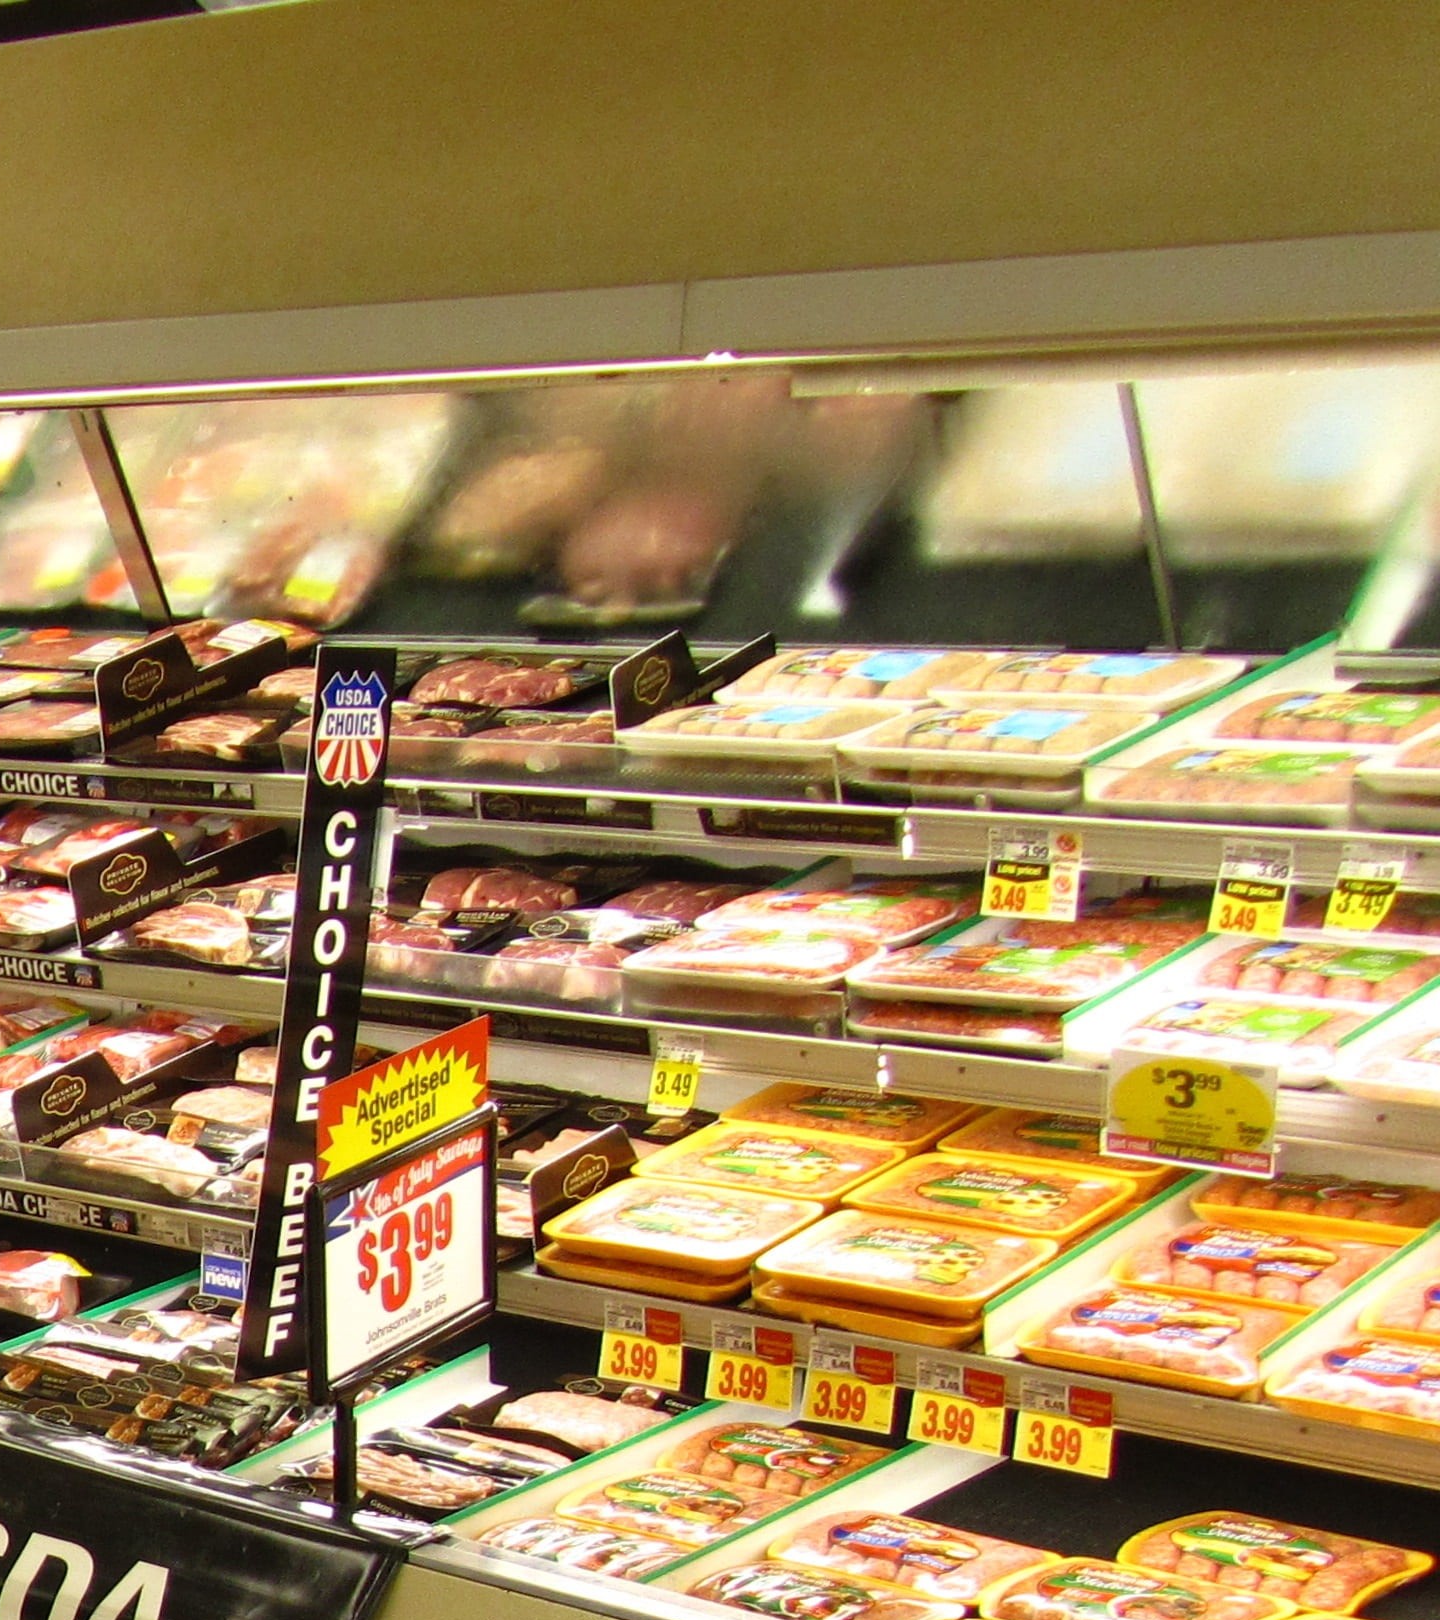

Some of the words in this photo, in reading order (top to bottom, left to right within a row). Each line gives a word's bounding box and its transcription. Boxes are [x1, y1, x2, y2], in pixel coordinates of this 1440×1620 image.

[336, 689, 373, 709] USDA
[325, 712, 378, 738] CHOICE
[1, 771, 80, 797] CHOICE
[990, 884, 1026, 912] 3.49
[1335, 890, 1387, 917] 3.49
[1219, 905, 1257, 933] 3.49
[295, 811, 356, 1124] CHOICE
[356, 1060, 451, 1127] Advertised
[655, 1071, 693, 1097] 3.49
[371, 1098, 437, 1148] Special
[392, 1177, 405, 1204] of
[407, 1163, 433, 1198] July
[435, 1135, 483, 1173] Savings
[265, 1162, 314, 1357] BEEF
[205, 1272, 242, 1290] new
[365, 1304, 422, 1346] Johnsonville
[423, 1290, 448, 1318] Brats
[610, 1340, 657, 1380] 3.99
[719, 1360, 767, 1401] 3.99
[814, 1380, 866, 1422] 3.99
[921, 1400, 974, 1445] 3.99
[1028, 1420, 1082, 1466] 3.99
